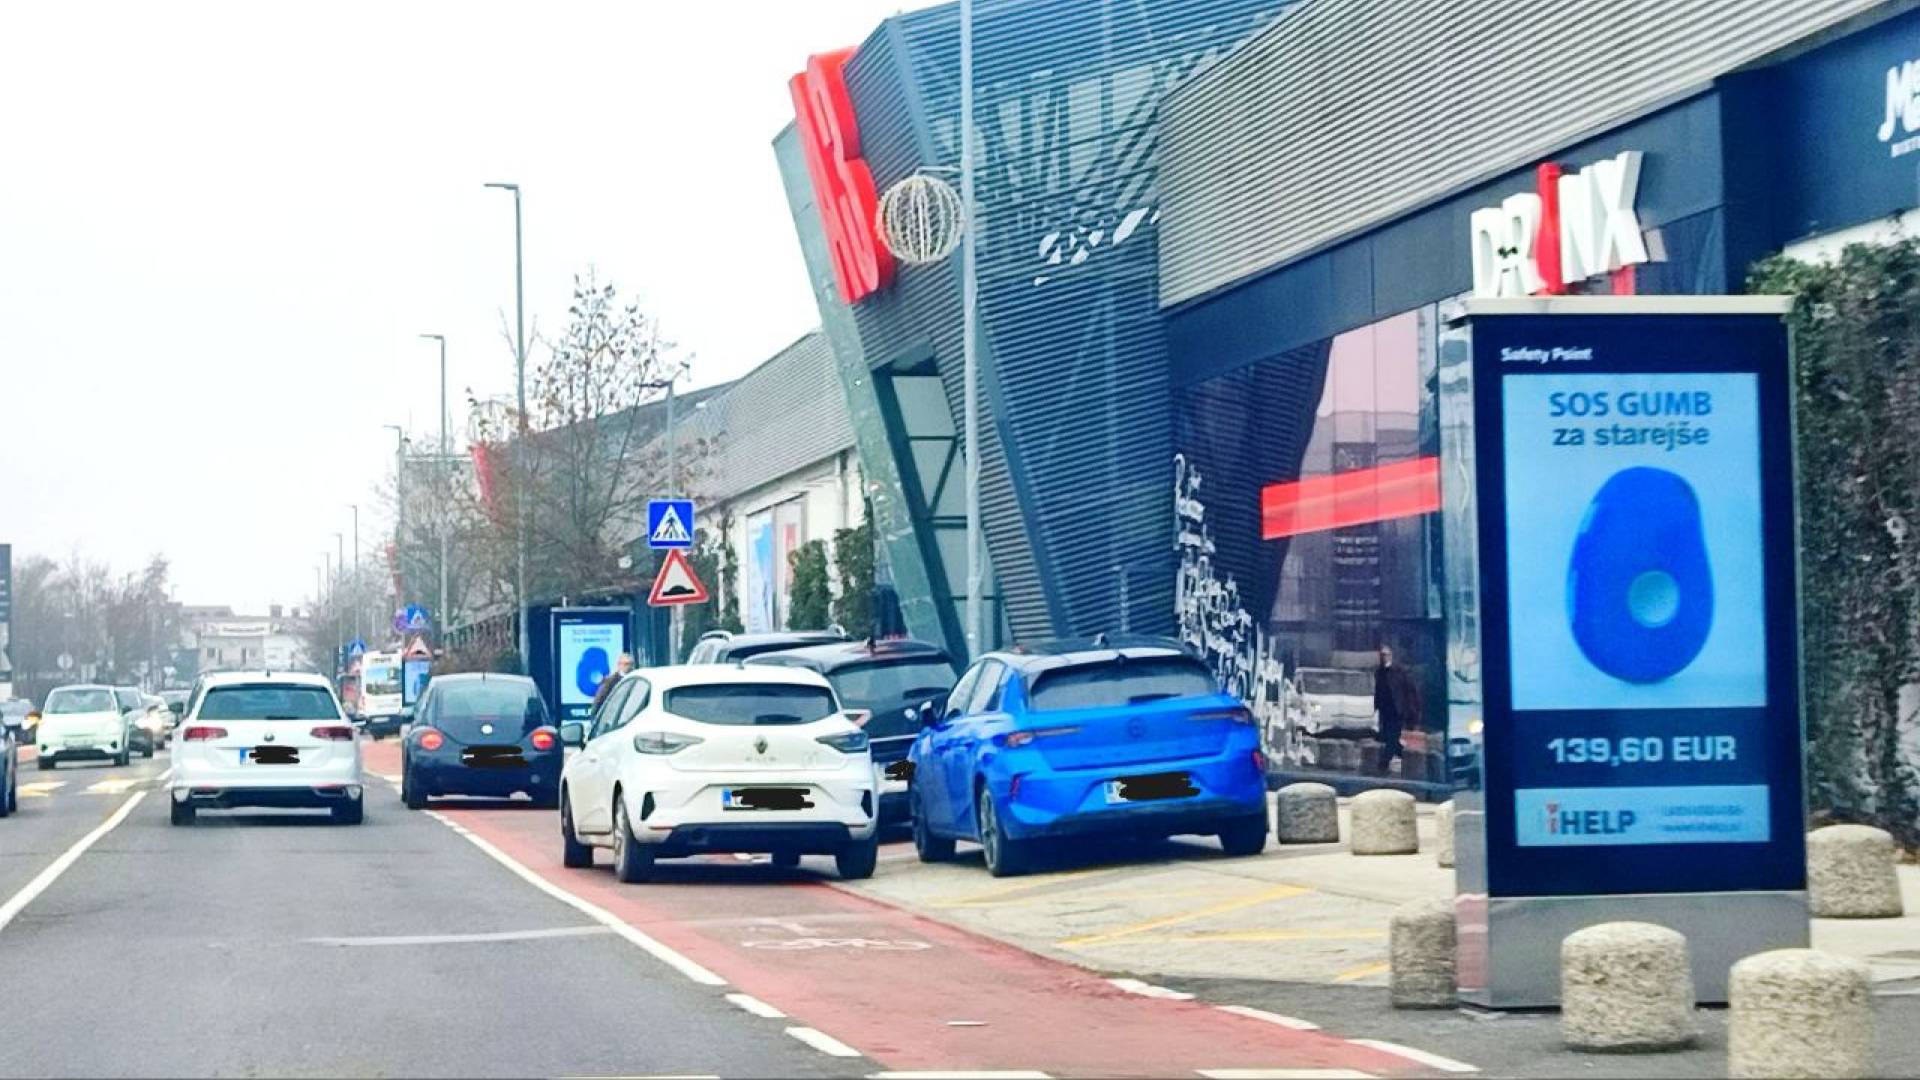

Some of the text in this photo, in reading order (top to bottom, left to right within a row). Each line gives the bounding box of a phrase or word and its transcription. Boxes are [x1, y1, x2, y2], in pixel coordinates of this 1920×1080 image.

[1471, 151, 1649, 297] DRINX
[1501, 346, 1593, 364] Safety Point
[1549, 391, 1712, 417] SOS GUMB
[1553, 421, 1710, 451] za starejše
[1548, 735, 1737, 767] 139,60 EUR
